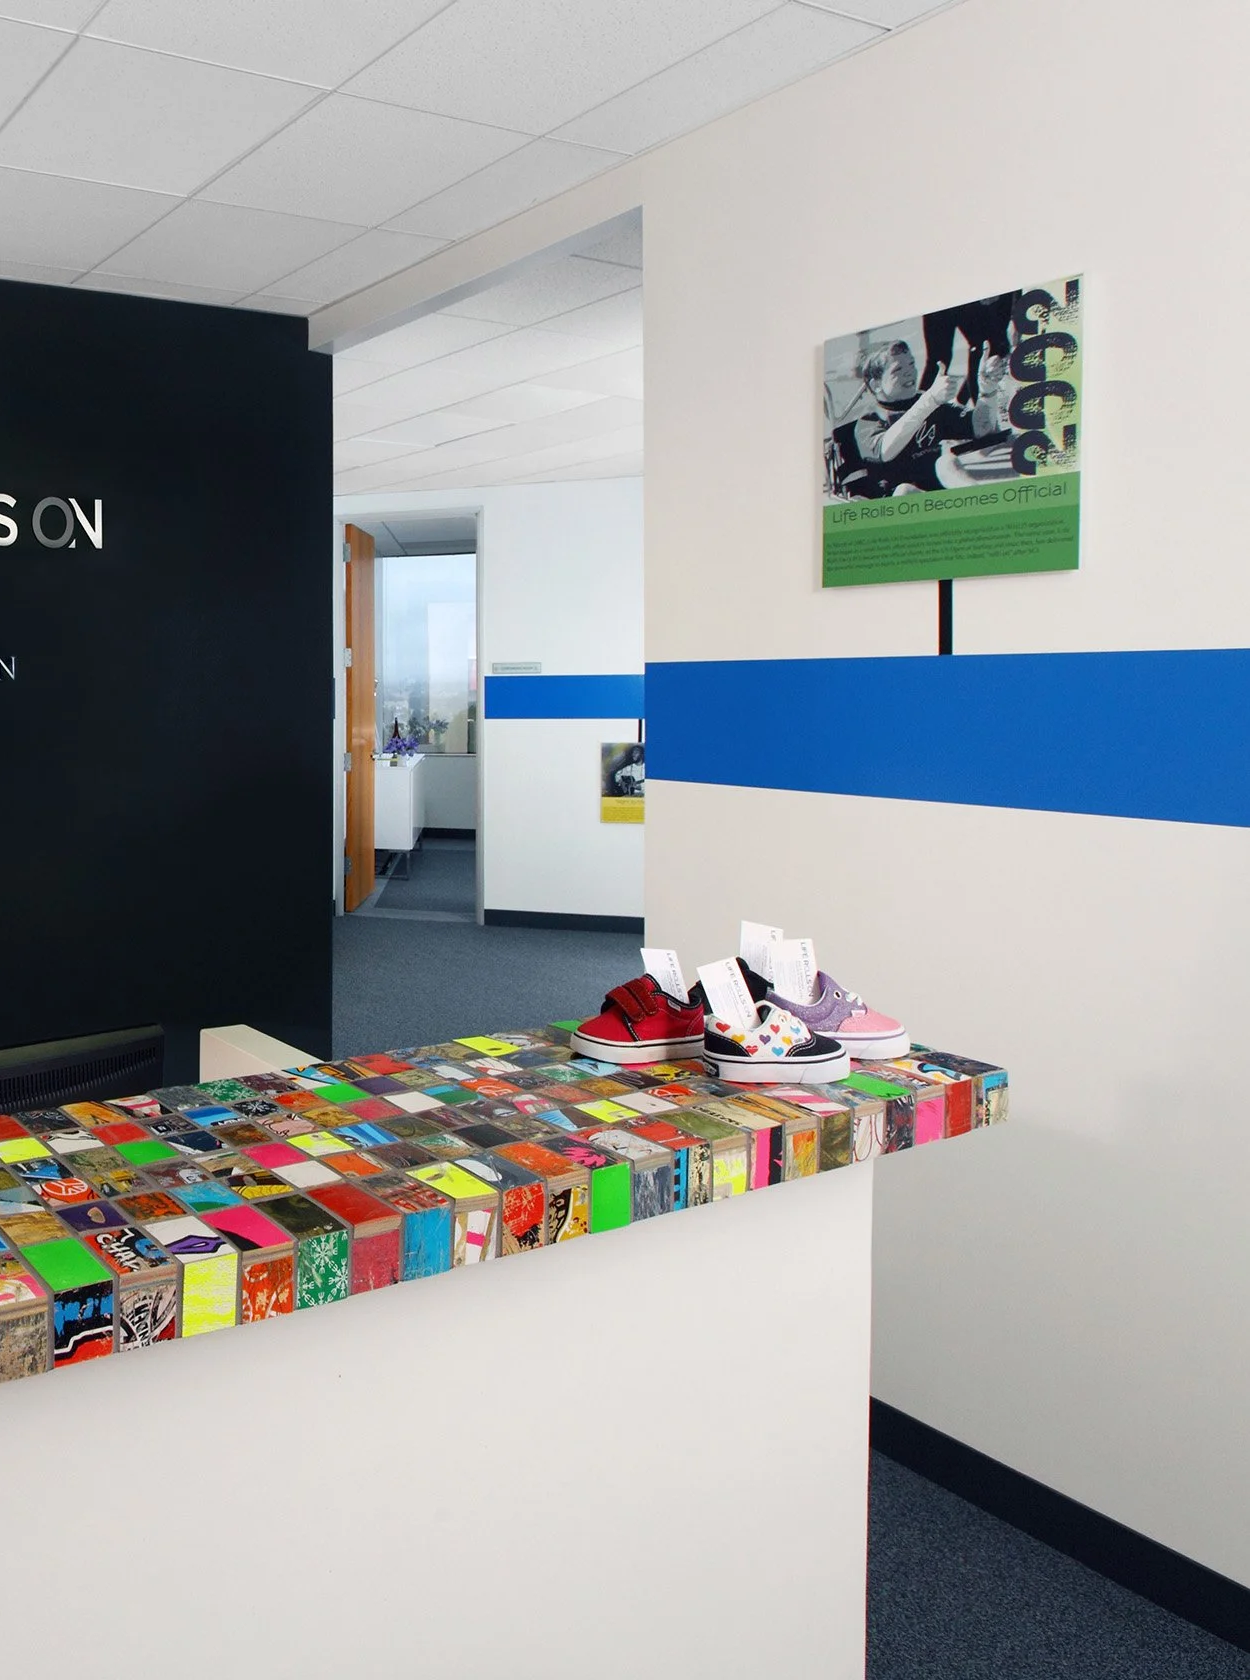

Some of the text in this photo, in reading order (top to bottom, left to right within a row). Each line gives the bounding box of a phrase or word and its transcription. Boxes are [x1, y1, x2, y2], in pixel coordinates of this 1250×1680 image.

[32, 496, 103, 549] ON
[832, 481, 1067, 525] Life Rolls On Becomes Official
